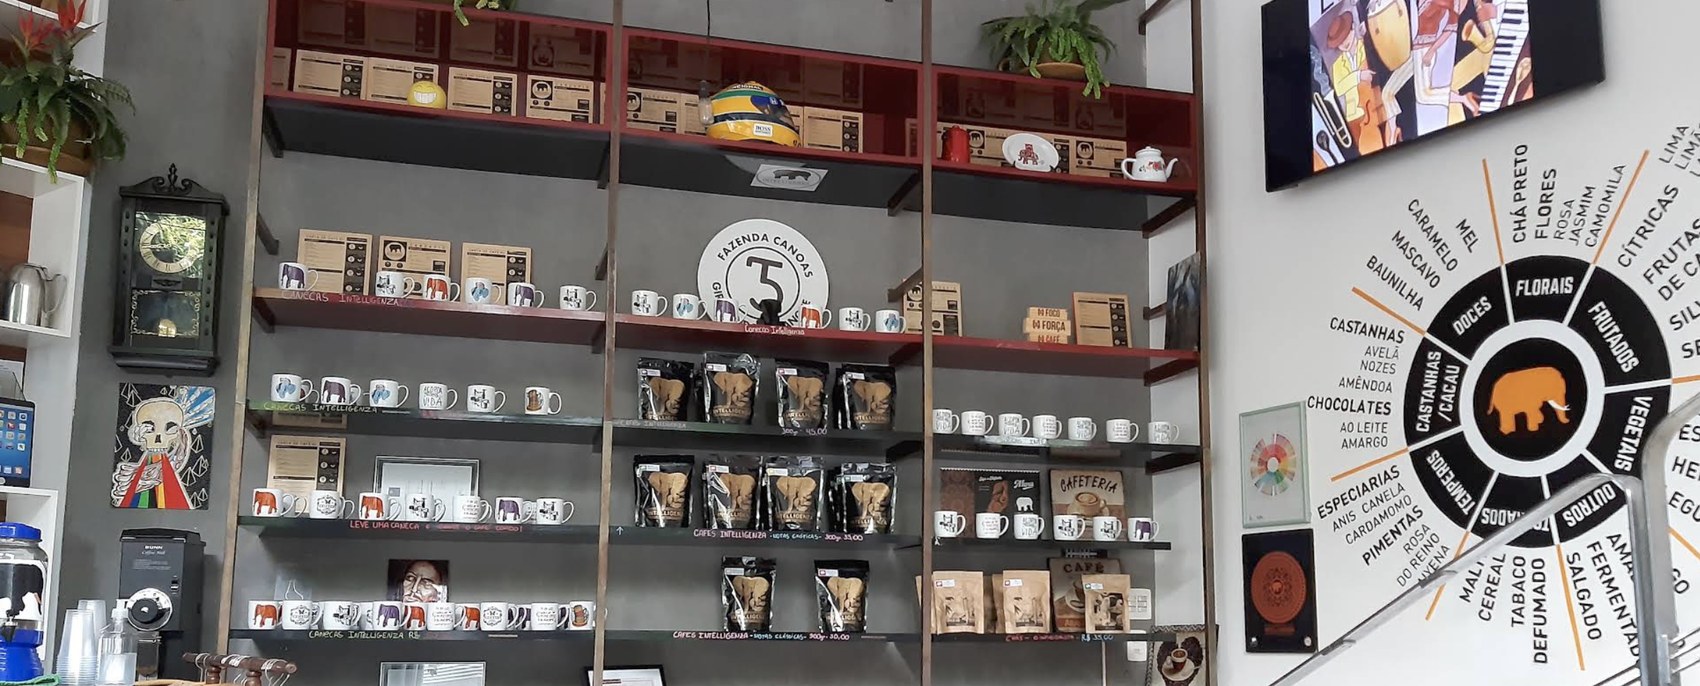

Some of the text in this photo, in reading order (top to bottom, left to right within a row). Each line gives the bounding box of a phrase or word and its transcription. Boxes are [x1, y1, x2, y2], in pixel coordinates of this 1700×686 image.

[1658, 126, 1690, 164] LIMA
[1509, 144, 1528, 243] CHÁ PRETO
[1535, 168, 1557, 240] FLORES
[1568, 185, 1596, 247] JASMIM
[1584, 164, 1626, 248] CAMOMILA
[1408, 199, 1458, 272] CARAMELO
[1455, 218, 1479, 254] MEL
[1553, 199, 1575, 240] ROSA
[1617, 184, 1679, 268] CÍTRICAS
[717, 233, 813, 278] FAZENDA CANOAS
[1391, 230, 1441, 289] MASCAVO
[1366, 255, 1424, 312] BAUNILHA
[1515, 276, 1574, 297] FLORAIS
[1658, 273, 1685, 301] DE
[1042, 321, 1066, 332] FORÇA
[1330, 317, 1405, 344] CASTANHAS
[1452, 296, 1492, 336] DOCES
[1587, 300, 1640, 373] FRUTADOS
[1360, 360, 1397, 375] NOZES
[1364, 345, 1400, 360] AVELÃ
[1307, 396, 1392, 416] CHOCOLATES
[1338, 375, 1393, 393] AMÊNDOA
[1415, 351, 1442, 433] CASTANHAS
[1437, 365, 1460, 422] /CACAU
[1340, 421, 1388, 434] AO LEITE
[1341, 436, 1388, 449] AMARGO
[1614, 396, 1654, 472] VEGETAIS
[1060, 475, 1118, 493] CAFETERIA
[1426, 449, 1477, 516] TEMPEROS
[1672, 456, 1700, 480] HE
[1317, 465, 1400, 519] ESPECIARIAS
[1332, 482, 1406, 532] ANIS CANELA
[1562, 483, 1617, 528] OUTROS
[350, 521, 369, 529] LEVE
[390, 522, 420, 531] CANECA
[720, 530, 767, 539] INTELLIGENZA
[1345, 494, 1412, 545] CARDAMOMO
[1362, 504, 1424, 566] PIMENTAS
[1403, 523, 1431, 555] ROSA
[1396, 533, 1440, 587] DO REINO
[1478, 553, 1506, 622] CEREAL
[1511, 555, 1527, 628] TABACO
[1566, 552, 1602, 640] SALGADO
[1531, 558, 1548, 665] DEFUMADO
[348, 630, 404, 640] INTELLIGENZA
[699, 632, 749, 640] INTELLIGENZA
